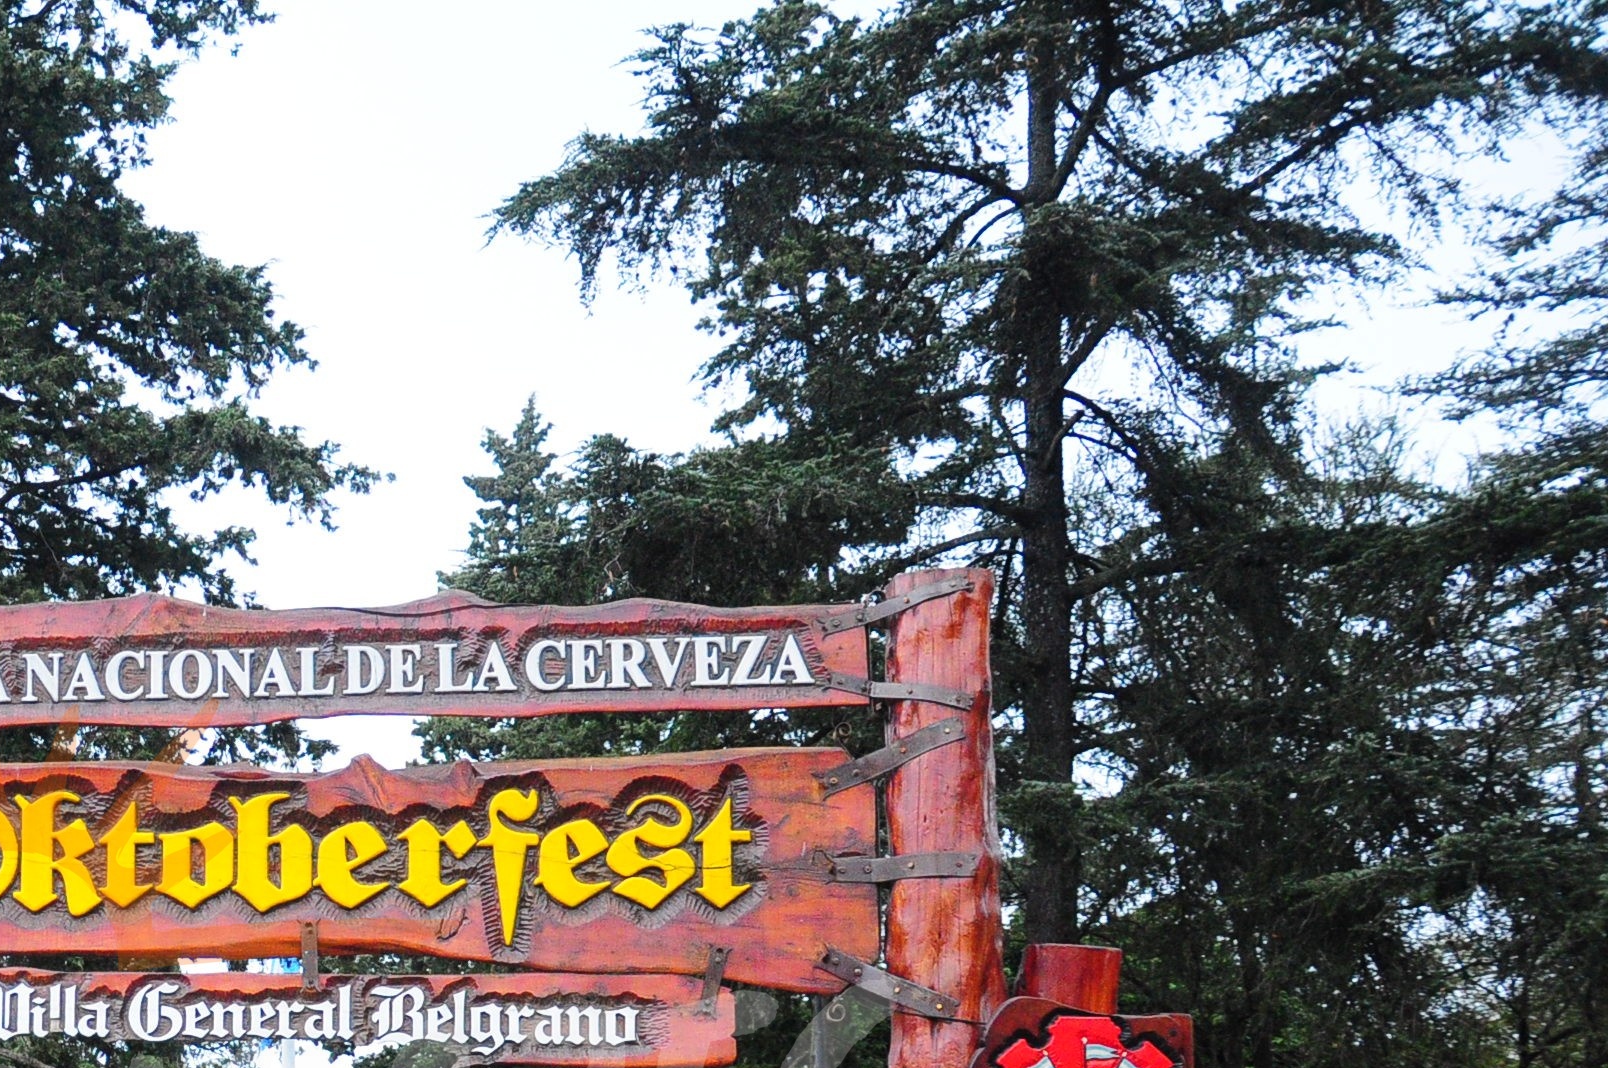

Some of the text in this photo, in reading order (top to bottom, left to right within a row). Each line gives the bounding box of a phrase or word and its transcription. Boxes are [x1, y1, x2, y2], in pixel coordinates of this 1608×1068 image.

[24, 645, 336, 703] NACIONAL
[343, 643, 423, 697] DE
[434, 640, 516, 693] LA
[525, 635, 815, 692] CERVEZA
[127, 981, 353, 1043] General
[371, 983, 640, 1055] Belgrano
